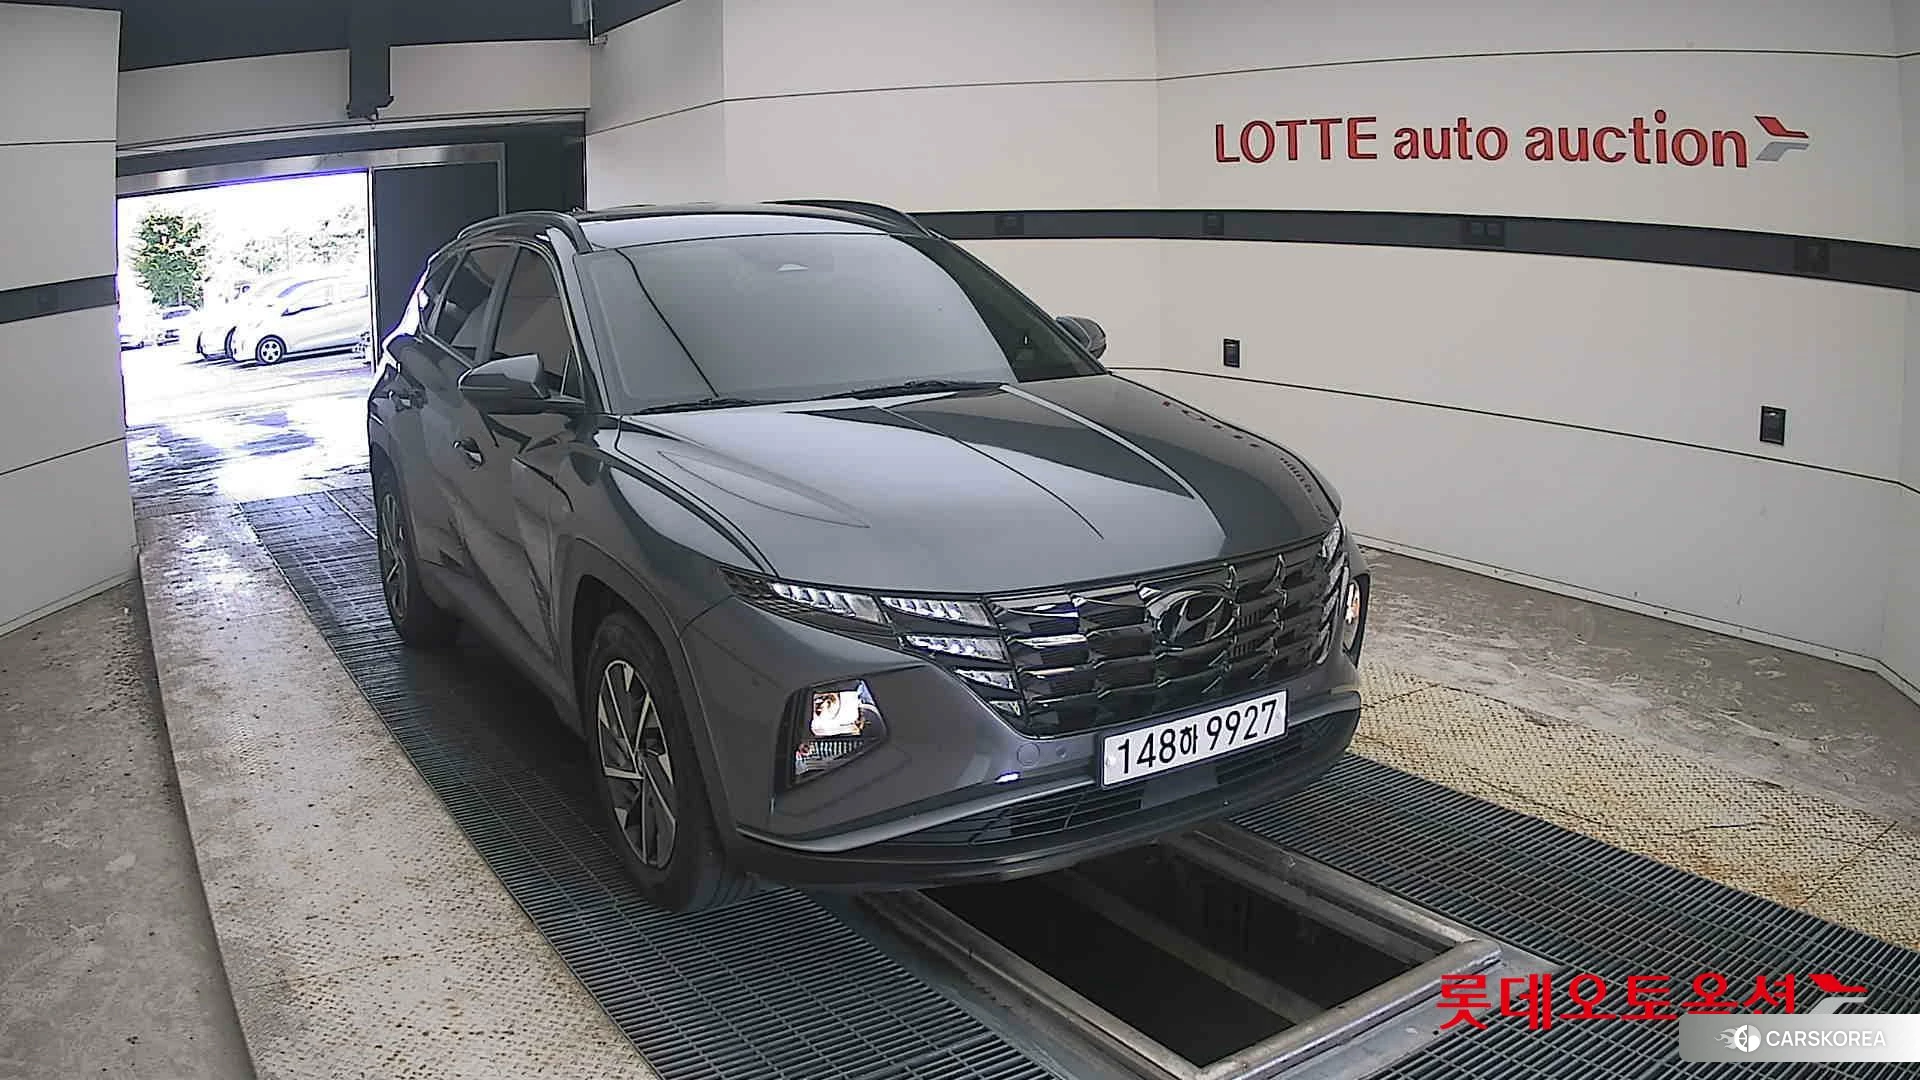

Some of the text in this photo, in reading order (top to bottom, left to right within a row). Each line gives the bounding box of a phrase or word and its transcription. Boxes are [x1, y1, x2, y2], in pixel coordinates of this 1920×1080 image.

[1215, 109, 1748, 168] LOTTE auto auction
[1117, 699, 1277, 774] 148하 9927
